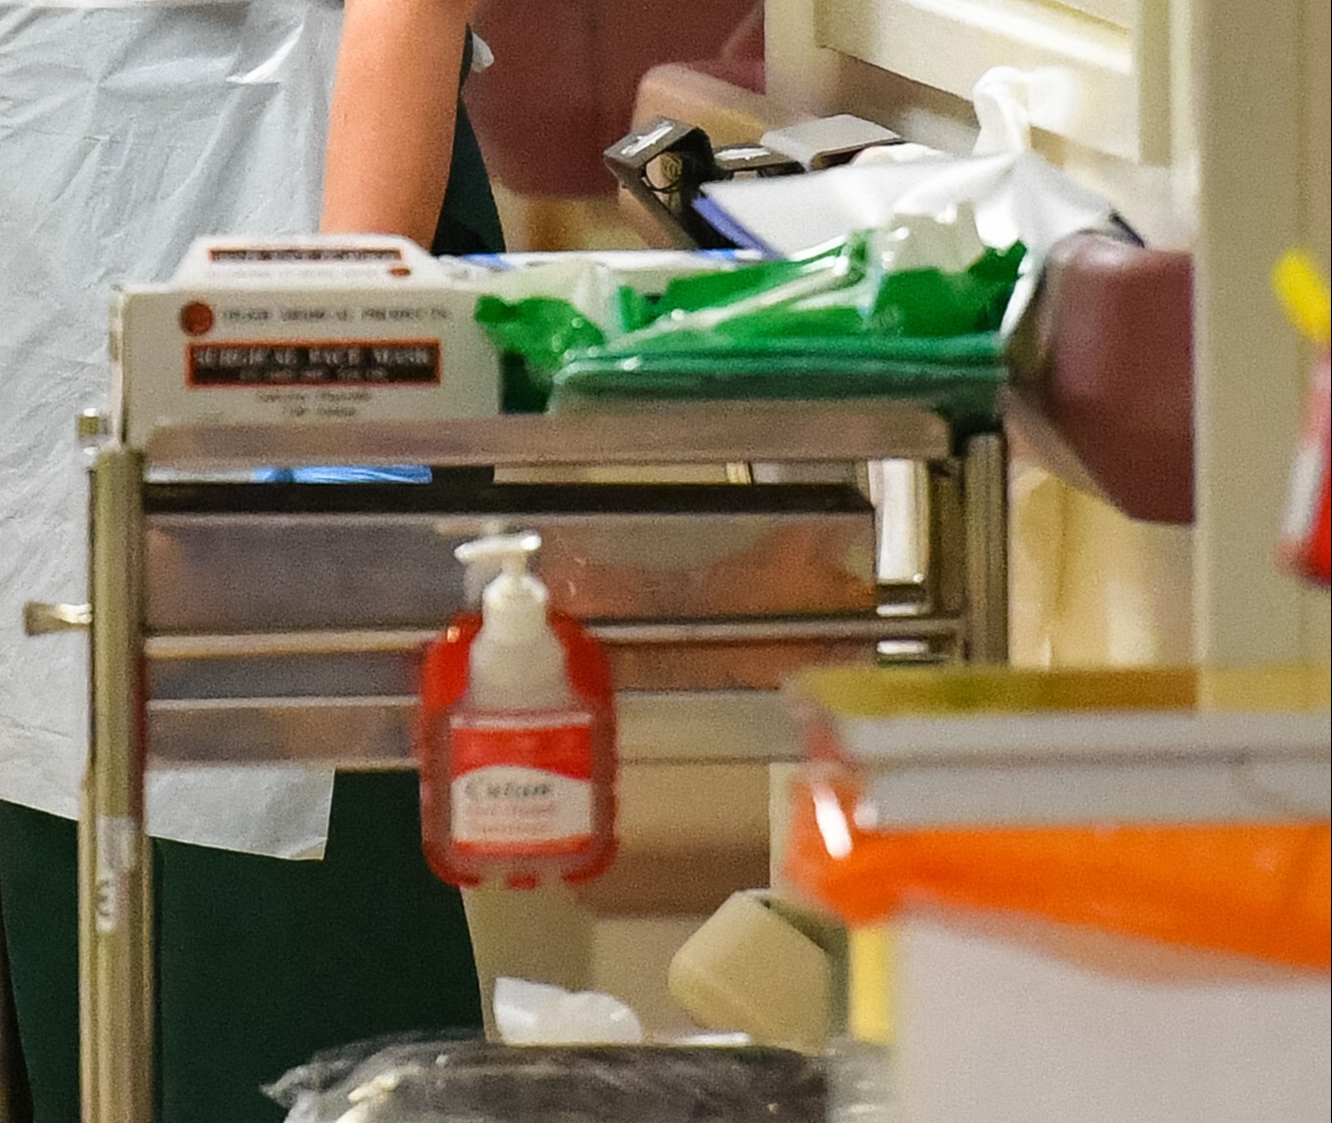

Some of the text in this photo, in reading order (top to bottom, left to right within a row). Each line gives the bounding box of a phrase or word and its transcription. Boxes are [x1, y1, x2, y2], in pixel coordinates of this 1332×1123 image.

[196, 347, 432, 365] SURGICAL FACE MASK
